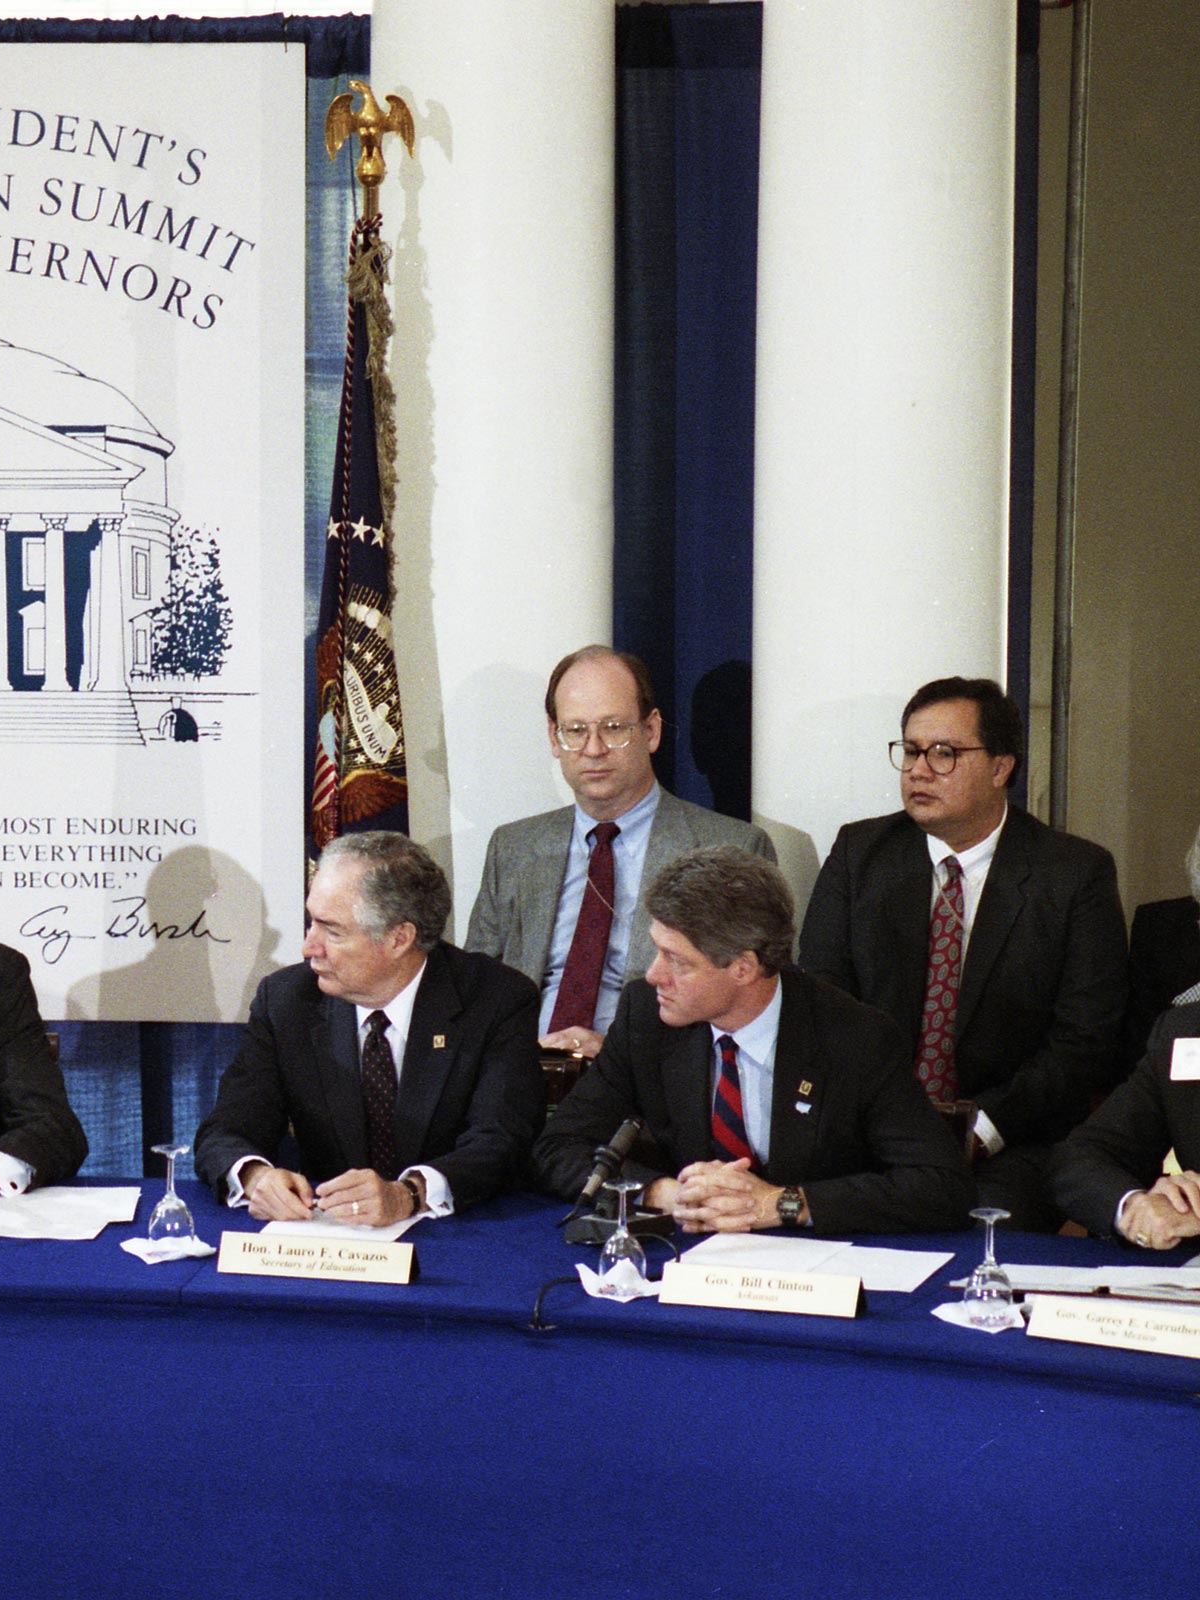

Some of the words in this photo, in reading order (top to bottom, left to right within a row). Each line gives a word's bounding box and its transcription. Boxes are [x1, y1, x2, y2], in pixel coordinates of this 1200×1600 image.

[39, 177, 256, 276] SUMMIT
[361, 724, 387, 758] UNUM
[66, 817, 197, 836] ENDURING
[2, 844, 162, 863] EVERYTHING
[13, 871, 138, 889] BECOME.”
[242, 1242, 272, 1254] Hon.
[278, 1244, 315, 1257] Lauro
[338, 1248, 389, 1262] Cavazos
[319, 1261, 367, 1273] Education
[705, 1274, 734, 1286] Gov.
[740, 1276, 762, 1288] Bill
[767, 1279, 814, 1292] Clinton
